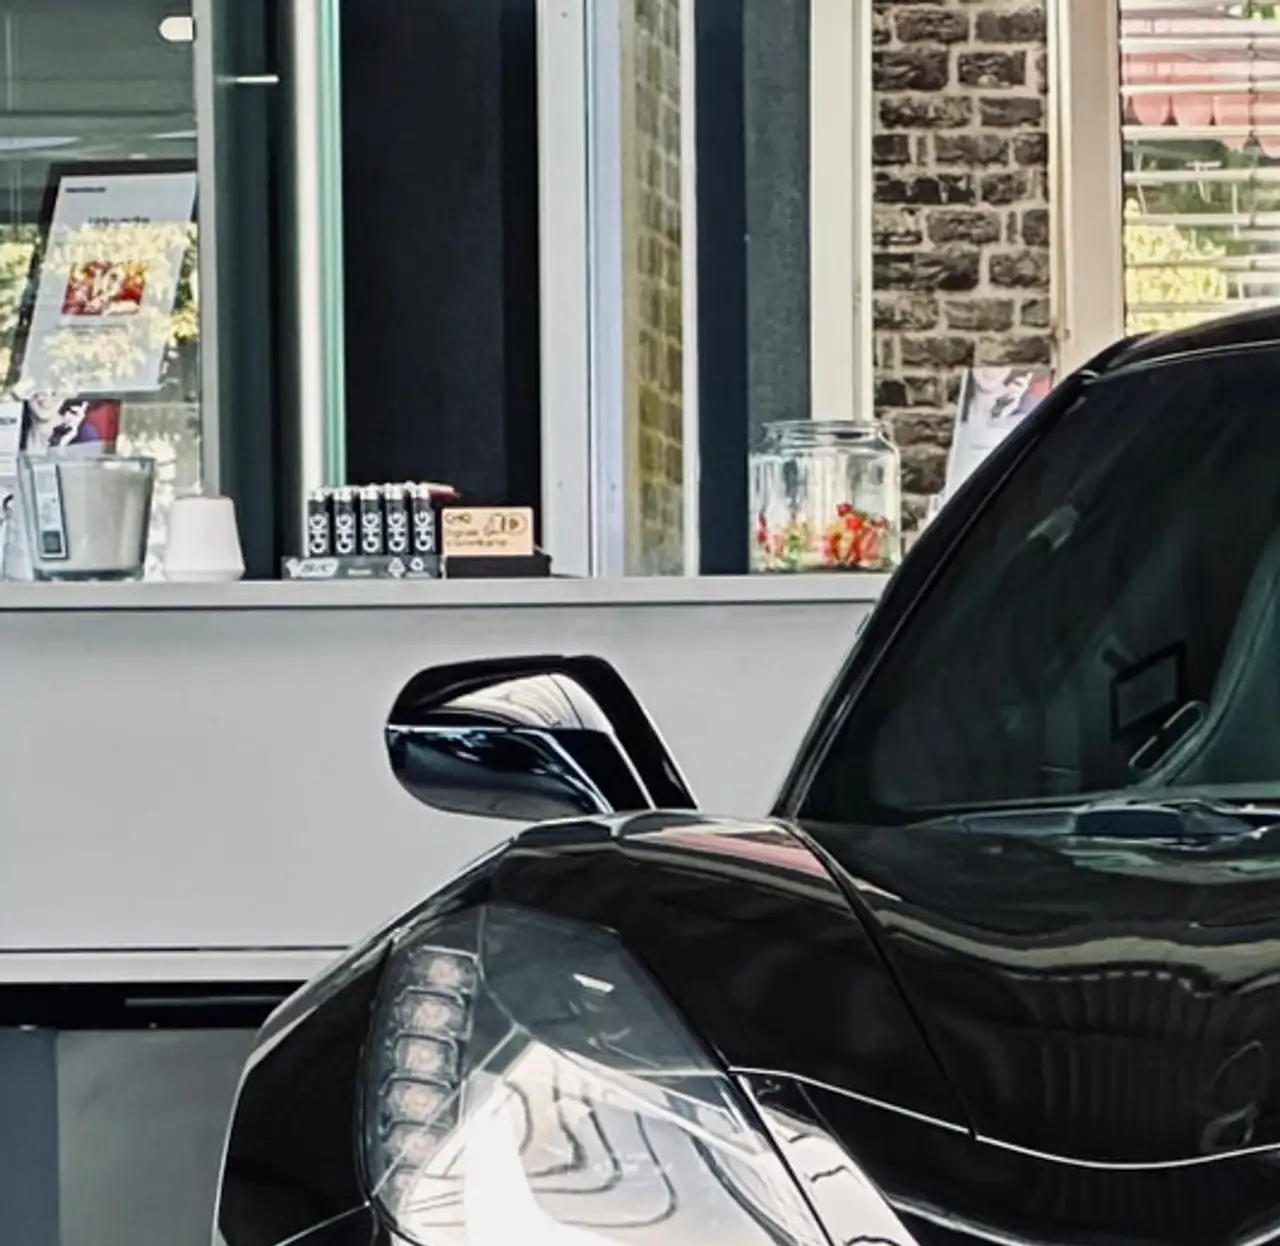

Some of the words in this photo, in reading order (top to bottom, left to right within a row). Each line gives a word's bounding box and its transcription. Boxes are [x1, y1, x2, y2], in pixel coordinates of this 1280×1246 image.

[362, 512, 379, 553] CHG
[387, 512, 405, 552] CHG
[414, 511, 432, 551] CHG
